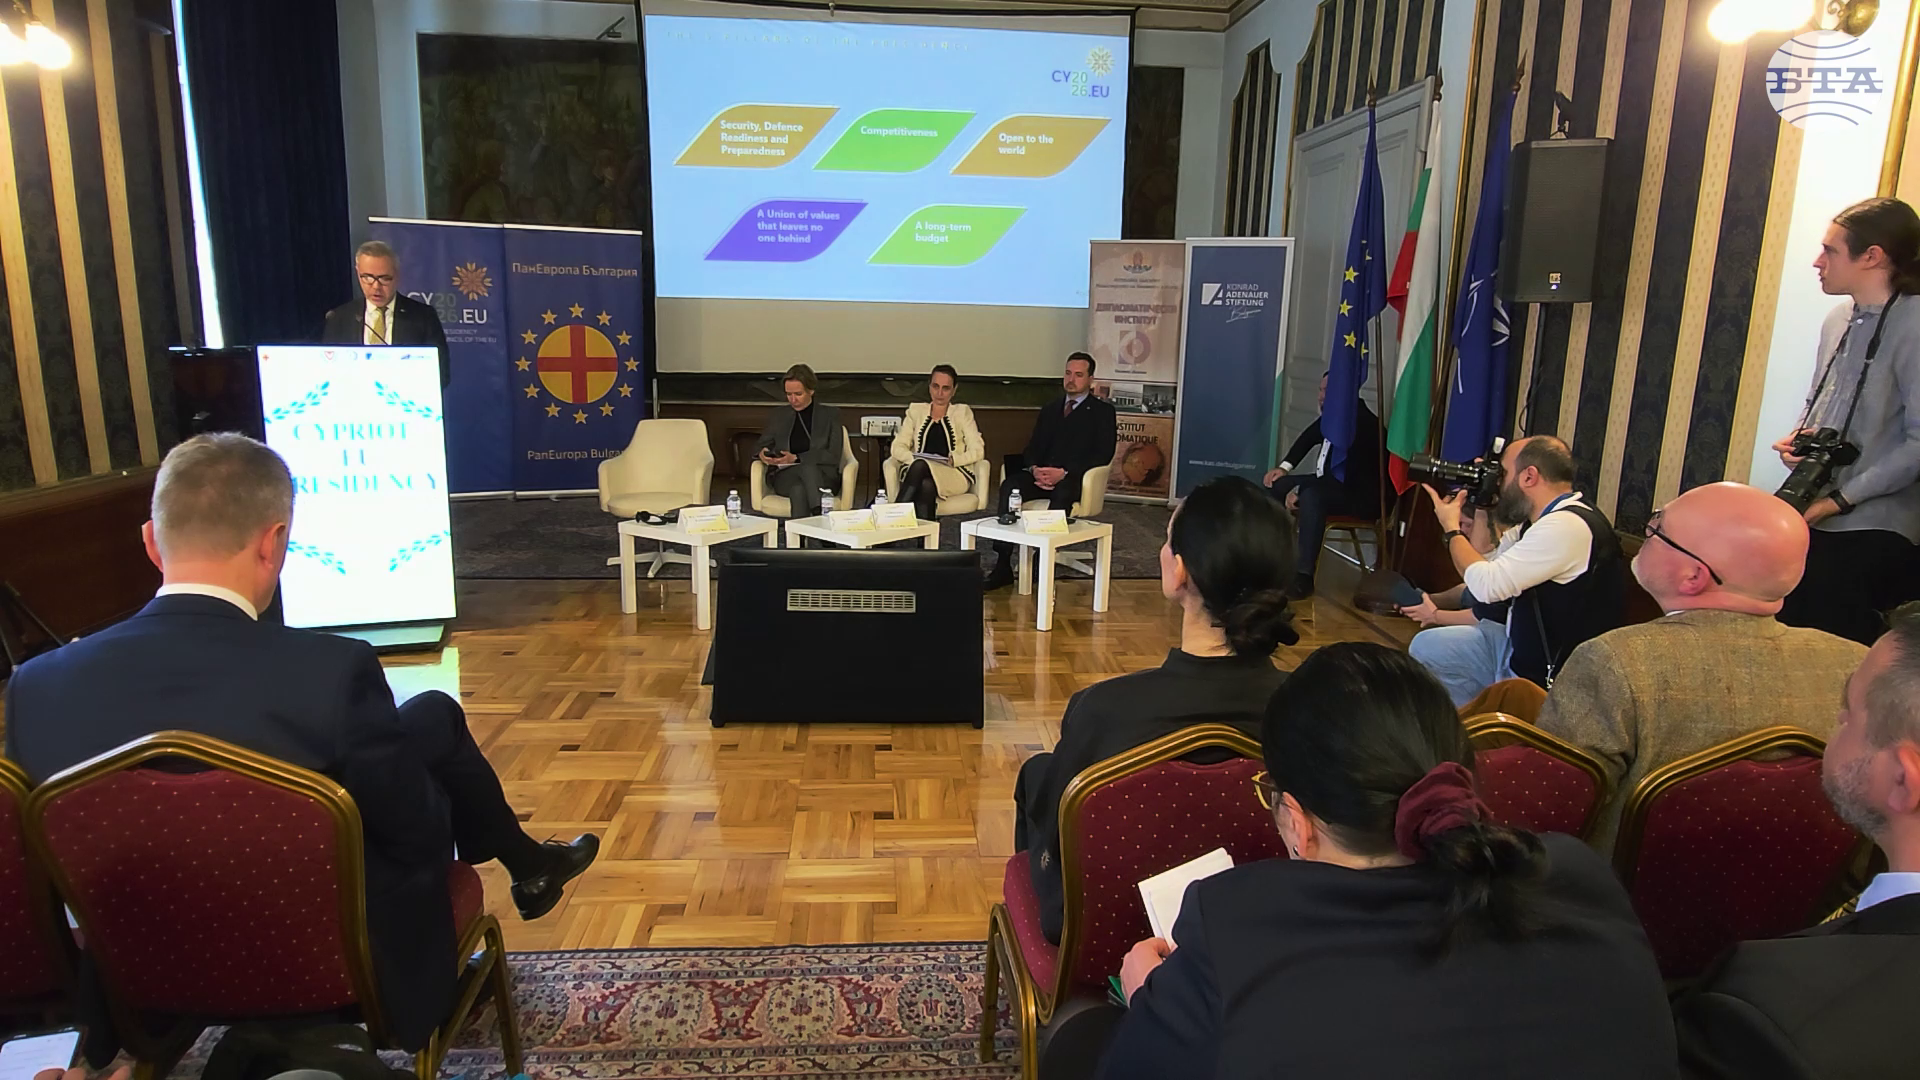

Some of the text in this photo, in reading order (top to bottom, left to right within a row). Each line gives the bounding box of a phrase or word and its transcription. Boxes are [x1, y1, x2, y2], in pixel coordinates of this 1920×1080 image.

[720, 120, 804, 132] Security, Defence
[860, 126, 938, 137] Competitiveness
[721, 132, 789, 144] Readiness and
[999, 133, 1054, 144] Open to the
[721, 145, 786, 156] Preparedness
[998, 145, 1025, 155] world
[757, 209, 840, 220] A Union of values
[757, 221, 824, 232] that leaves no
[915, 221, 971, 232] A long-term
[757, 234, 811, 243] one behind
[915, 233, 949, 244] budget
[512, 262, 638, 279] ПанЕвропа България
[1225, 291, 1269, 299] ADENAUER
[1225, 299, 1264, 307] STIFTUNG
[293, 422, 409, 441] CYPRIOT
[527, 449, 588, 461] PanEuropa
[291, 472, 438, 494] RESIDENCY
